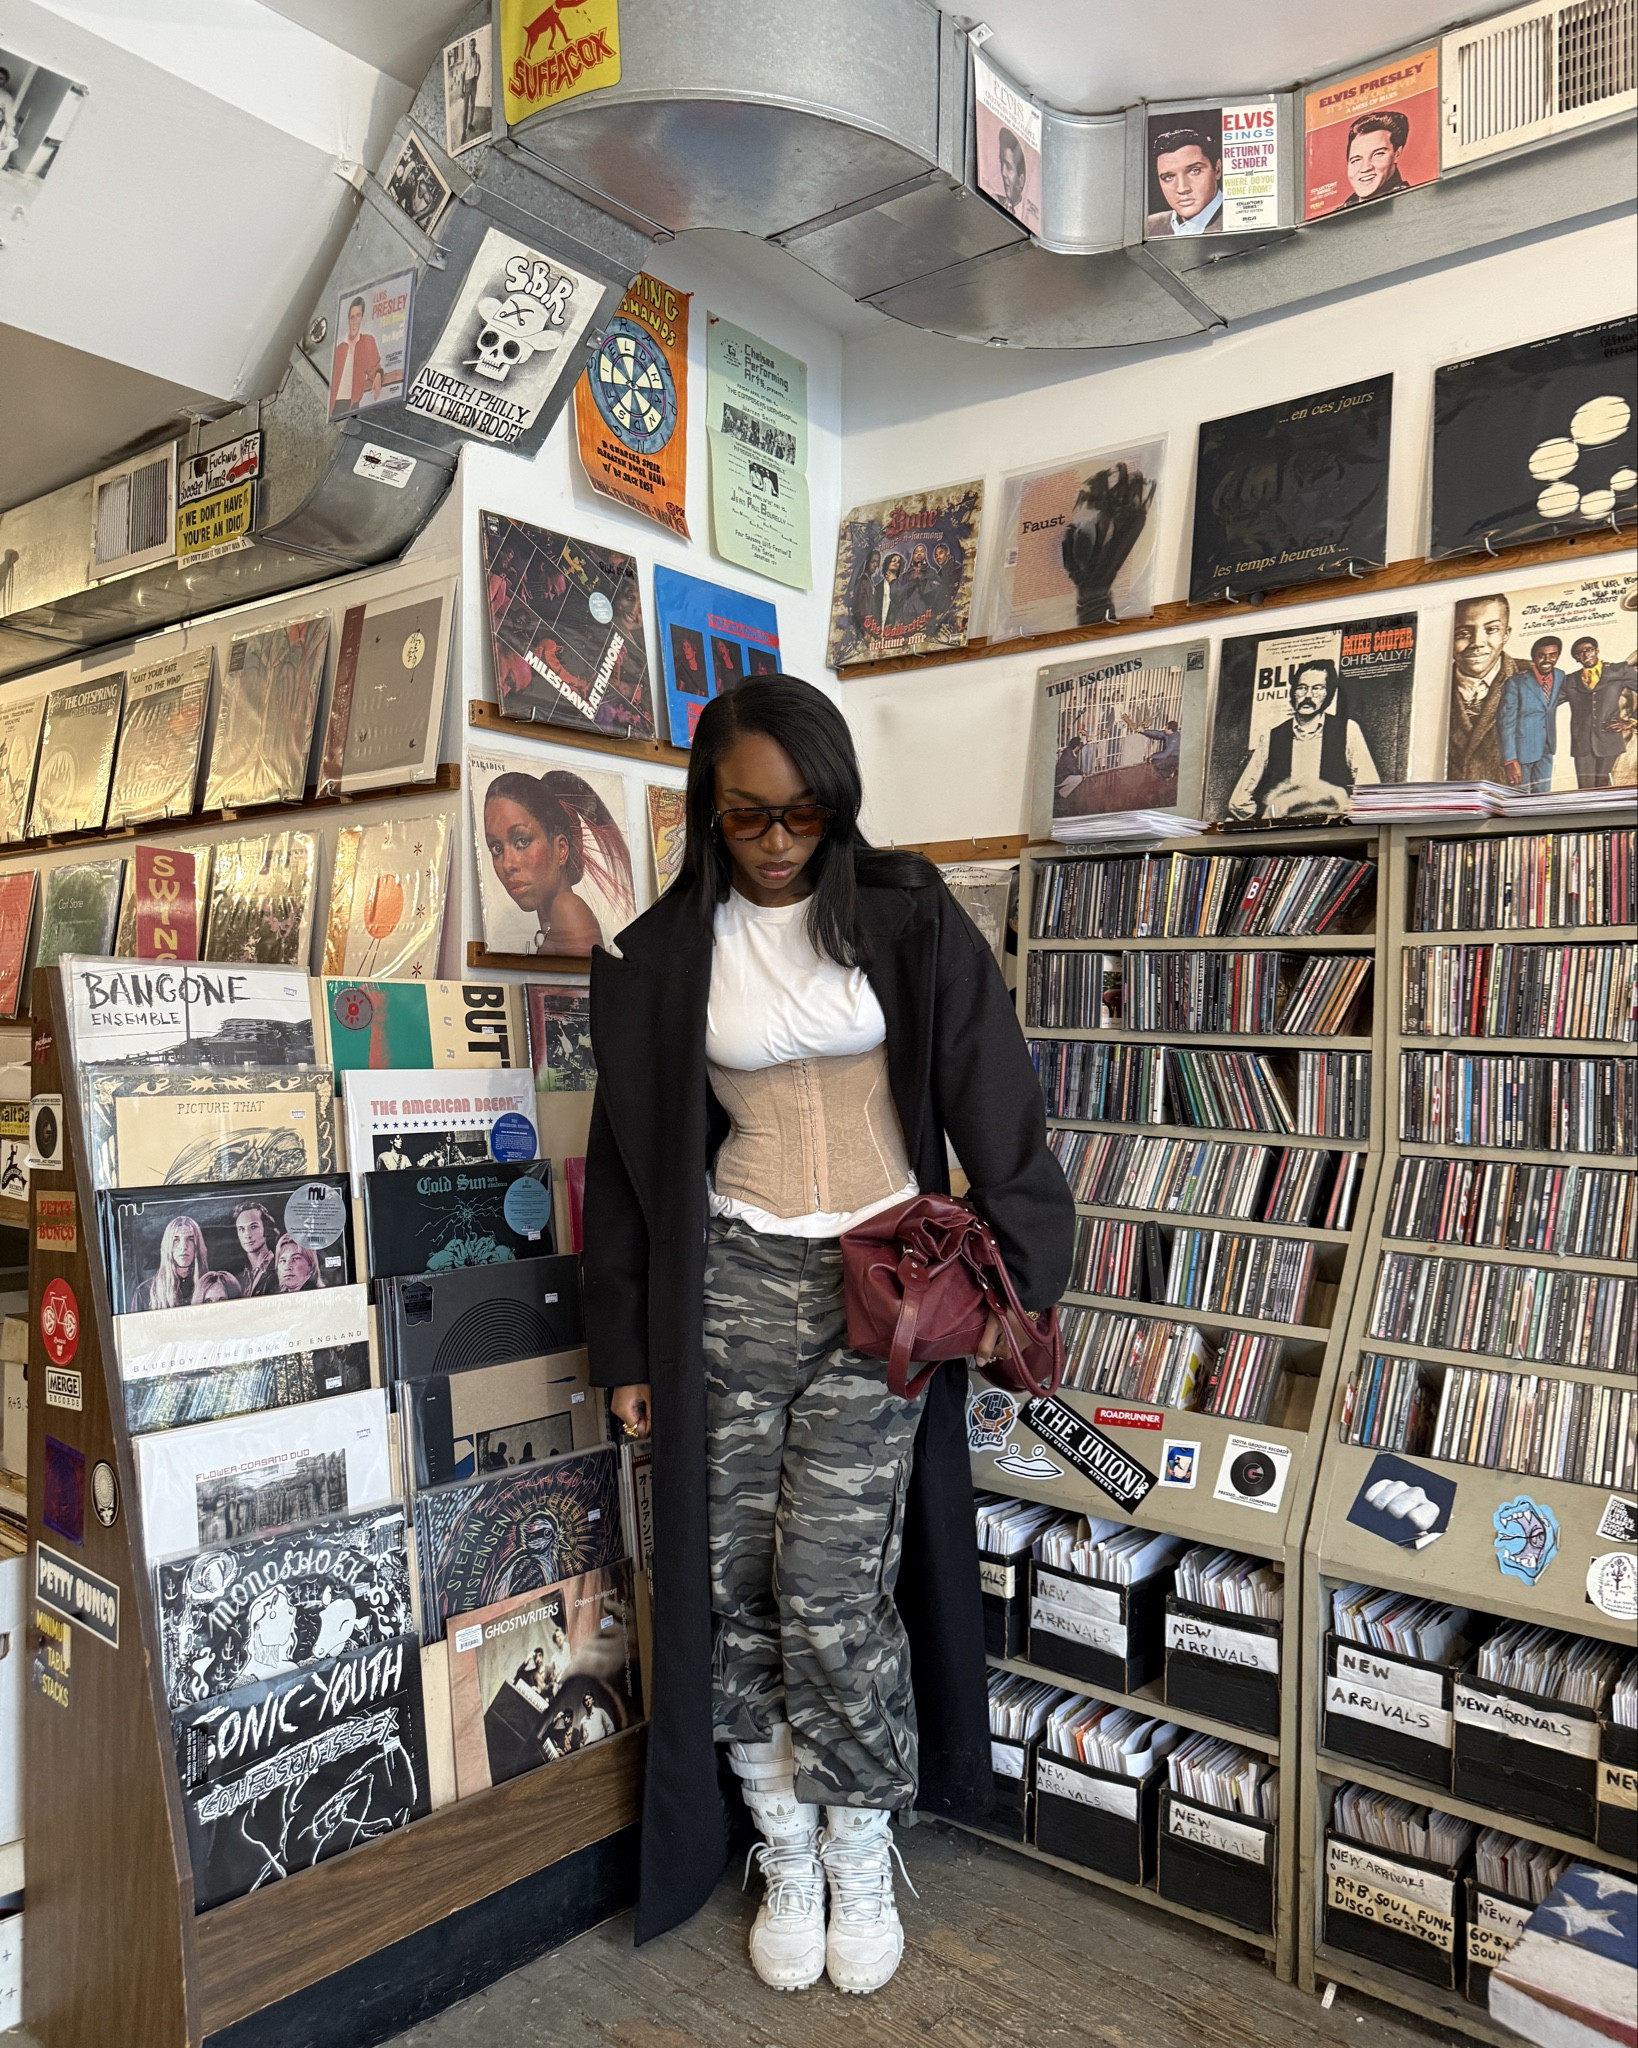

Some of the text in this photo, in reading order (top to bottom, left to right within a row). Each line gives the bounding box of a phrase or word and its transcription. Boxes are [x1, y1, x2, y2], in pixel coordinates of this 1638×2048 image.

[508, 26, 617, 104] SUFFACOX
[1319, 62, 1425, 109] ELVIS PRESLEY
[993, 79, 1025, 122] ELVIS
[1223, 110, 1274, 131] ELVIS
[1224, 128, 1274, 141] SINGS
[1224, 143, 1274, 159] RETURN TO
[1231, 156, 1267, 170] SENDER
[1224, 175, 1275, 187] WHERE DO YOU
[1226, 184, 1272, 196] COME FROM?
[371, 293, 408, 321] PRESLEY
[744, 343, 775, 369] Chelsea
[744, 356, 789, 393] Performing
[408, 385, 483, 431] SOUTHERN
[417, 367, 530, 425] NORTH PHILLY
[1311, 391, 1374, 416] ces jours
[179, 493, 243, 531] IF WE DON'T HAVE
[1022, 513, 1066, 534] Faust
[183, 519, 224, 547] YOU'RE AN
[190, 549, 202, 564] DON'T
[1212, 556, 1277, 578] les temps
[1521, 595, 1618, 615] The Ruffin Brothers
[1342, 633, 1373, 656] MIKE
[1373, 627, 1414, 653] COOPER
[148, 663, 178, 680] YOUR FATE
[597, 631, 625, 696] FILLMORE
[1341, 656, 1359, 667] OH
[144, 681, 165, 694] TO THE
[524, 650, 596, 720] MILES DAVIS
[1046, 678, 1075, 698] THE
[1078, 657, 1143, 688] ESCORTS
[64, 683, 118, 711] THE OFFSPRING
[71, 698, 116, 718] GREATEST HITS
[588, 687, 603, 710] AT
[471, 759, 507, 773] PARADISE
[1065, 842, 1122, 856] ROCK
[58, 897, 84, 910] Carl Stone
[148, 855, 181, 961] SWIN
[81, 971, 251, 1010] BANGONE
[91, 1012, 182, 1027] ENSEMBLE
[177, 1100, 265, 1115] PICTURE THAT
[371, 1100, 398, 1116] THE
[400, 1097, 471, 1115] AMERICAN
[416, 1173, 486, 1196] Cold Sun
[40, 1200, 72, 1217] PETTY
[38, 1224, 75, 1241] BUNCO
[133, 1330, 363, 1373] BLUEBOY THE BANK OF ENGLAND
[49, 1374, 78, 1395] MERGE
[49, 1394, 80, 1408] RECORDS
[1099, 1409, 1161, 1423] ROADRUNNER
[969, 1429, 1003, 1448] Reverb
[1039, 1402, 1140, 1493] THE UNION
[1232, 1438, 1290, 1455] GOTTA GROOVE RECORDS
[195, 1448, 310, 1482] FLOWER-CORSANO DUO
[1036, 1425, 1125, 1502] WEST UNION ST. ATHENS, OH
[446, 1518, 485, 1592] STEFAN
[461, 1512, 513, 1612] HRISTENSEN
[39, 1556, 116, 1628] PETTY BUNCO
[574, 1593, 594, 1608] Objects
[1039, 1579, 1070, 1602] NEW
[36, 1609, 64, 1643] MINIMU
[484, 1601, 559, 1640] GHOSTWRITERS
[1033, 1608, 1112, 1644] ARRIVALS
[1173, 1623, 1212, 1639] NEW
[1174, 1637, 1260, 1667] ARRIVALS
[1342, 1653, 1391, 1680] NEW
[41, 1673, 69, 1709] STACKS
[1331, 1686, 1431, 1729] ARRIVALS
[1454, 1694, 1572, 1737] NEW ARRIVALS
[200, 1745, 319, 1822] CONFUSION
[349, 1707, 399, 1746] SEX
[1037, 1761, 1069, 1781] NEW
[1036, 1776, 1102, 1807] ARRIVALS
[1174, 1807, 1211, 1829] NEW
[1172, 1821, 1261, 1862] ARRIVALS
[1331, 1847, 1426, 1889] NEW ARRIVALS
[1334, 1891, 1375, 1917] DISCO
[1478, 1903, 1512, 1925] NEW
[1417, 1909, 1453, 1933] FUNK
